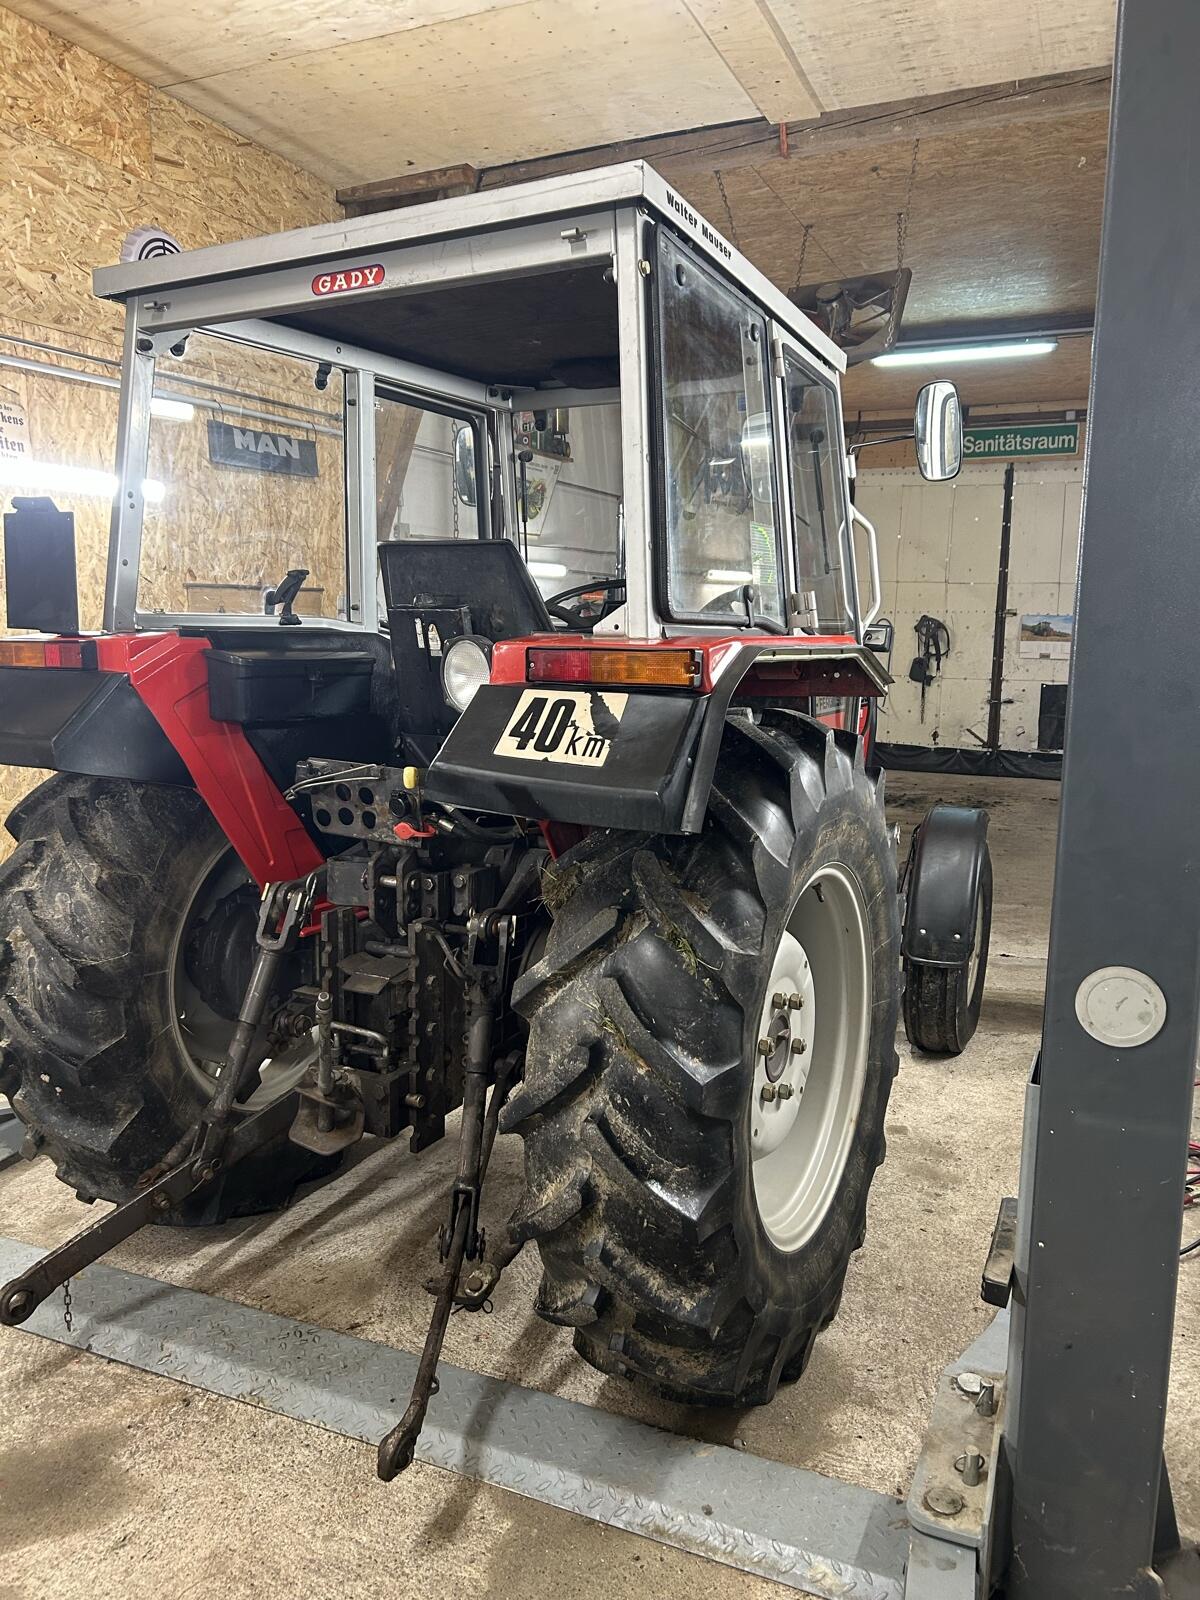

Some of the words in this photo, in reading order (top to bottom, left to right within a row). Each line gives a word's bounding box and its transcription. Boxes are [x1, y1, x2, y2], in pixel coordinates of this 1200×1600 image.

[666, 189, 698, 229] Walter
[701, 222, 732, 261] Mauser
[318, 267, 379, 293] GADY
[232, 427, 301, 460] MAN
[963, 433, 1076, 454] Sanitätsraum
[508, 697, 577, 753] 40
[564, 726, 606, 759] km
